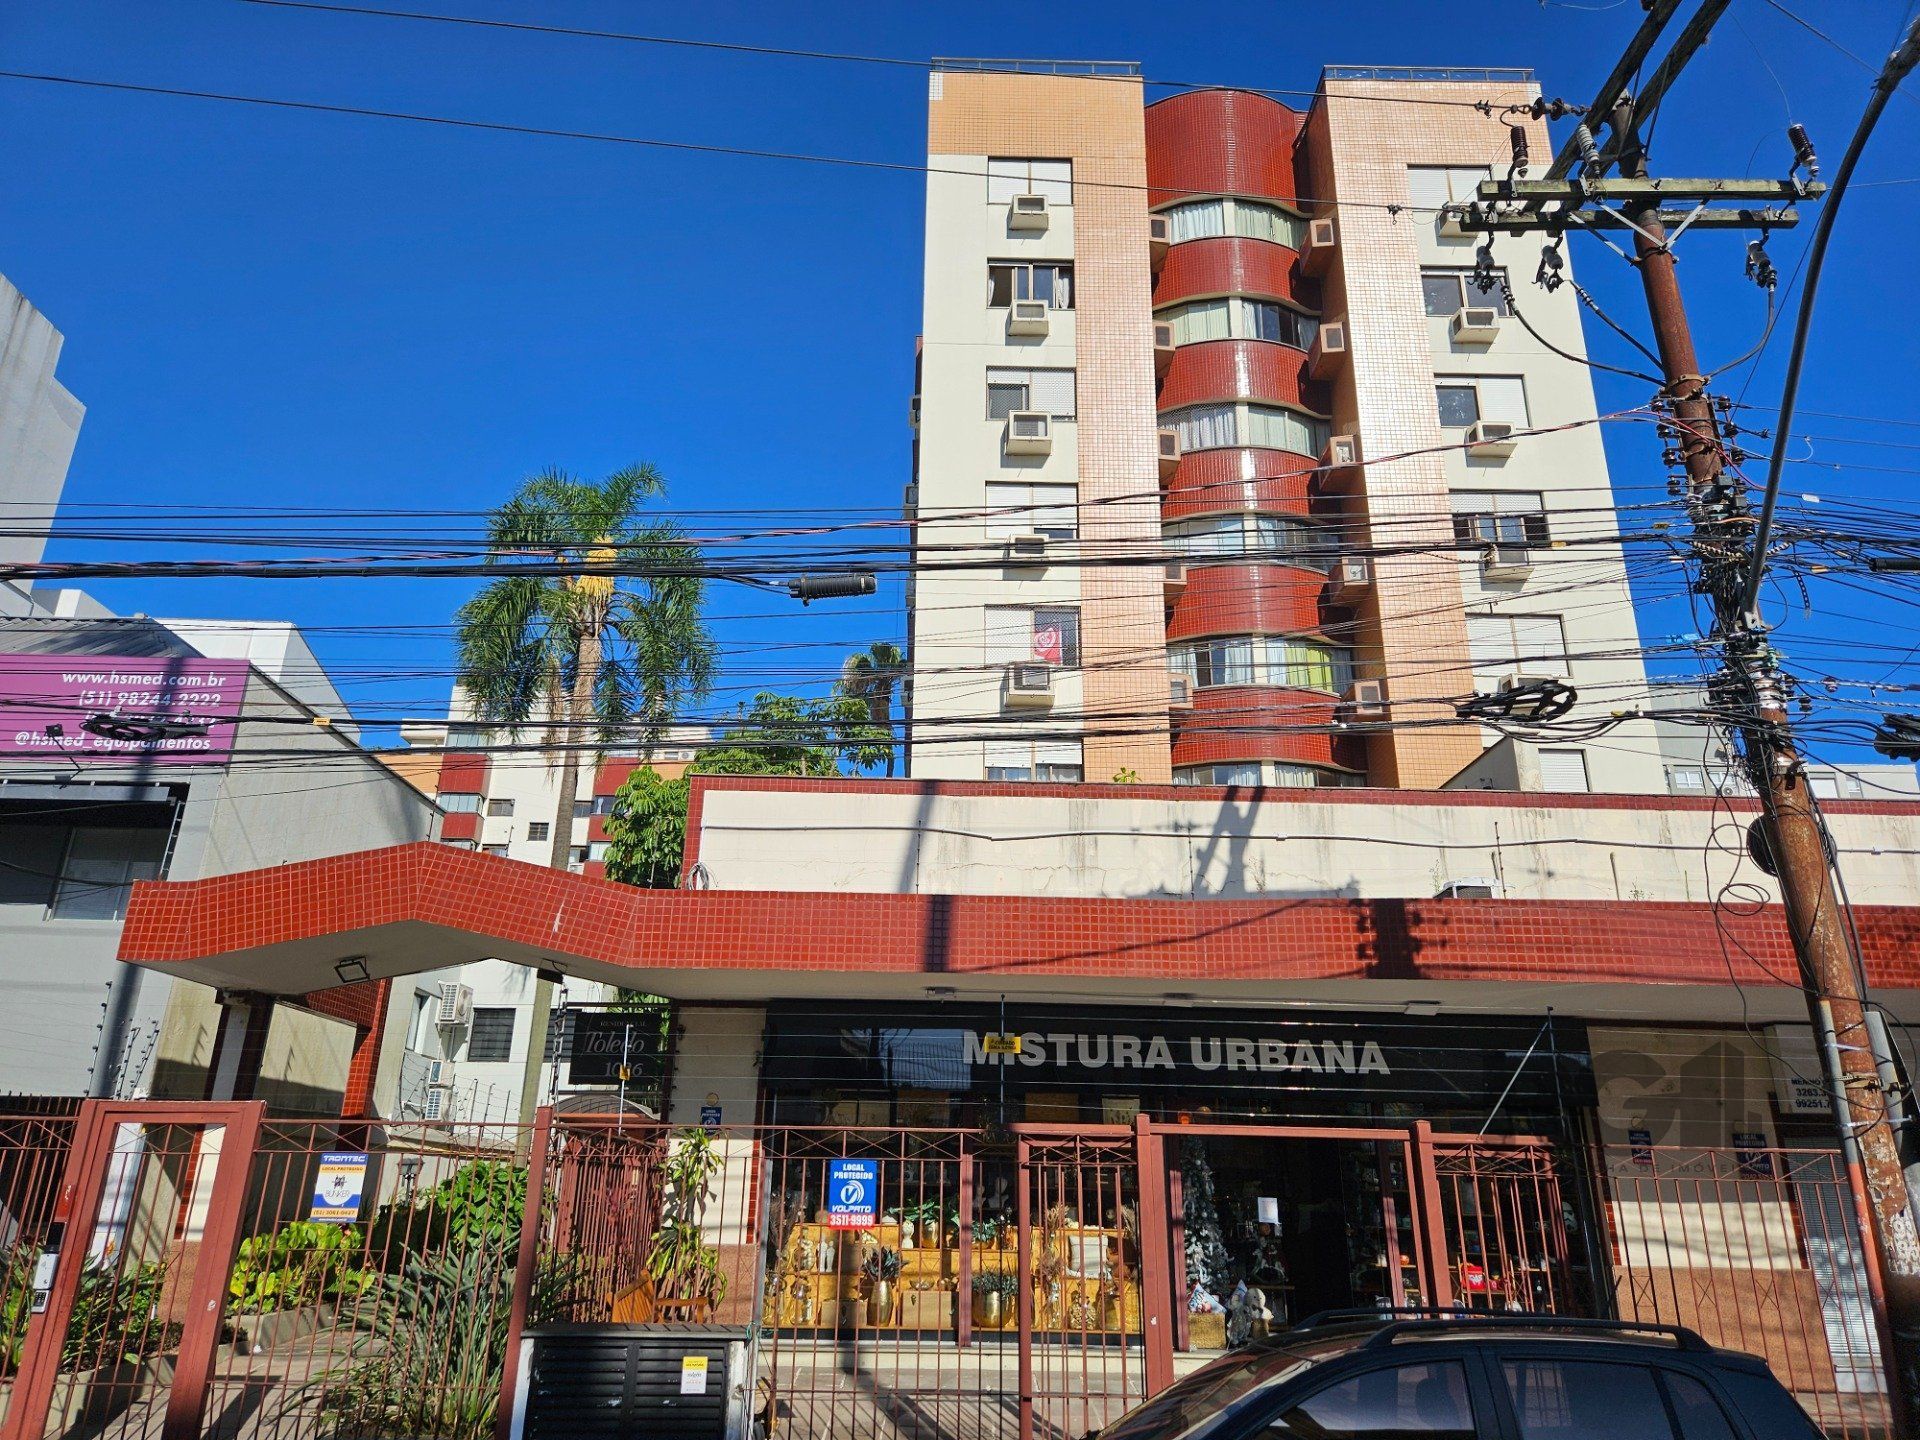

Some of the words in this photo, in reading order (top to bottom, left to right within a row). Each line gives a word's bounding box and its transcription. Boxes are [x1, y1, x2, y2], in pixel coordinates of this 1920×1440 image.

[62, 670, 226, 687] www.hsmed.com.br
[79, 690, 112, 706] (51)
[117, 692, 222, 708] 98244.2222
[963, 1031, 1176, 1069] MISTURA
[1191, 1036, 1391, 1075] URBANA
[604, 1062, 644, 1077] 106
[842, 1163, 865, 1171] LOCAL
[831, 1205, 872, 1213] VOLPATO
[830, 1214, 874, 1226] 3511-9999
